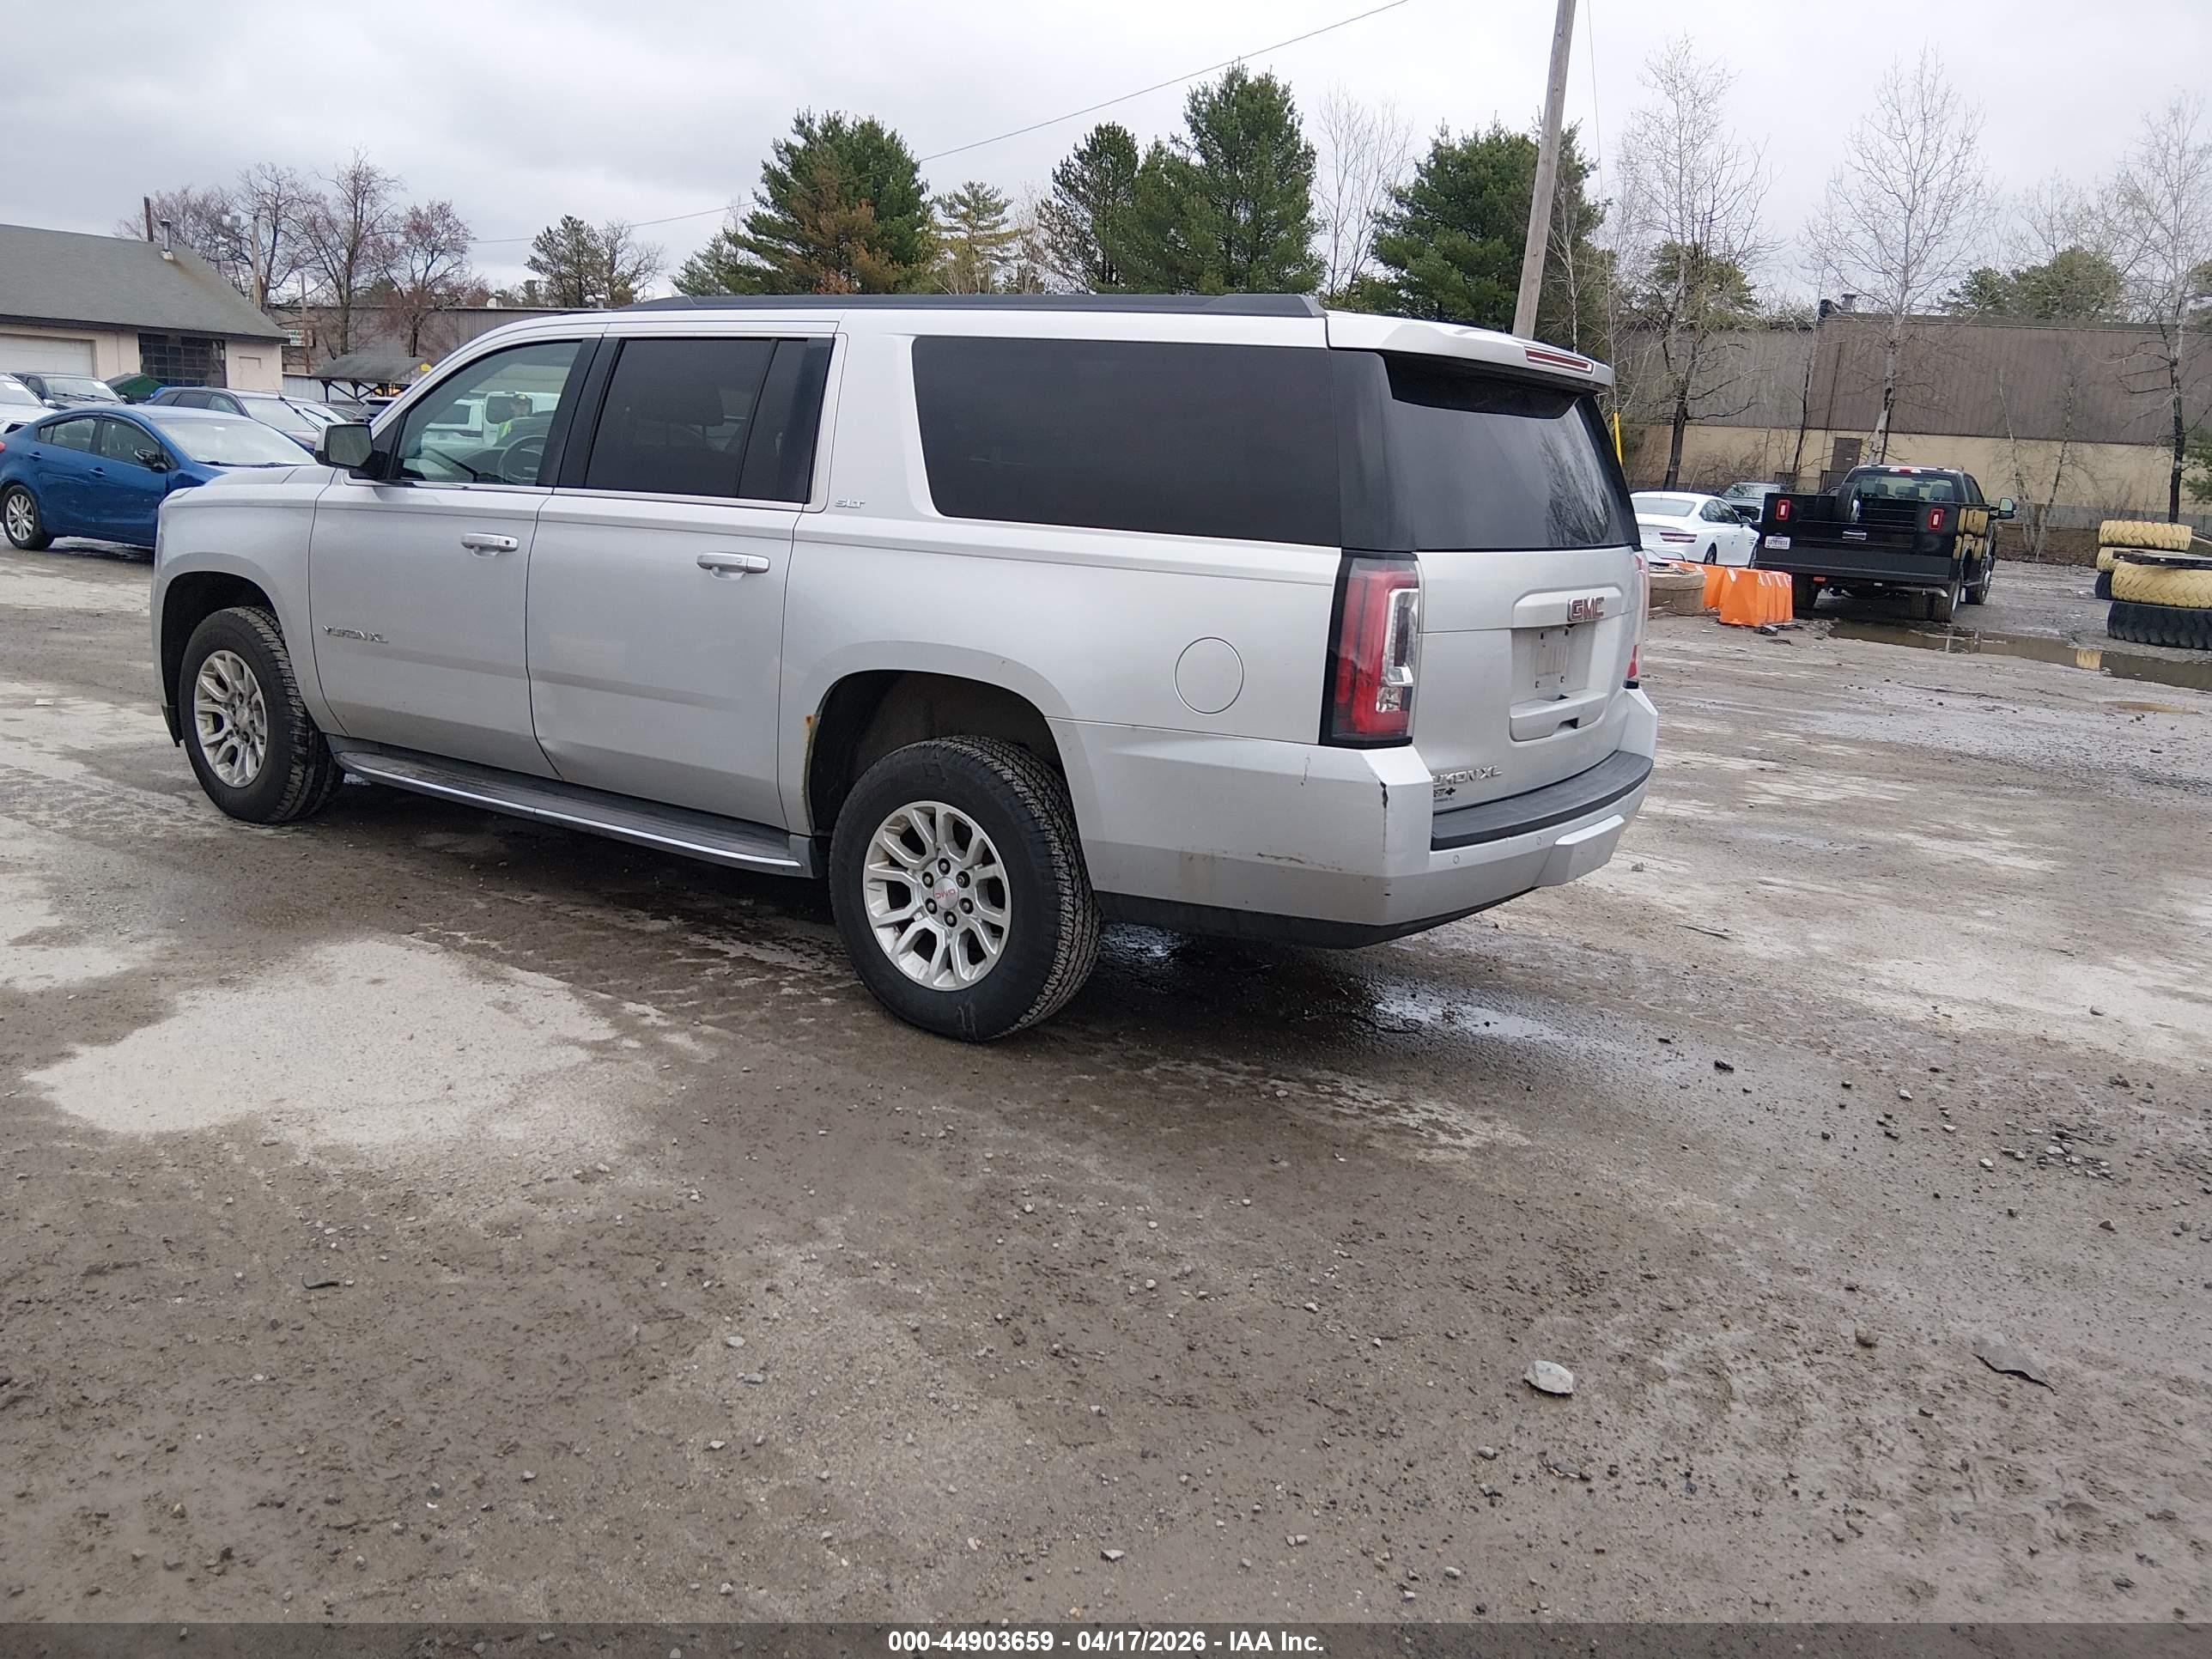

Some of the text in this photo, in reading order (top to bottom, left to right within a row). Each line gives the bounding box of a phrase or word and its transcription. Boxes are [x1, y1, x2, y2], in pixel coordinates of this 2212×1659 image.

[834, 499, 866, 509] SLT
[1567, 597, 1605, 622] GMC
[1432, 766, 1504, 787] UKON XL
